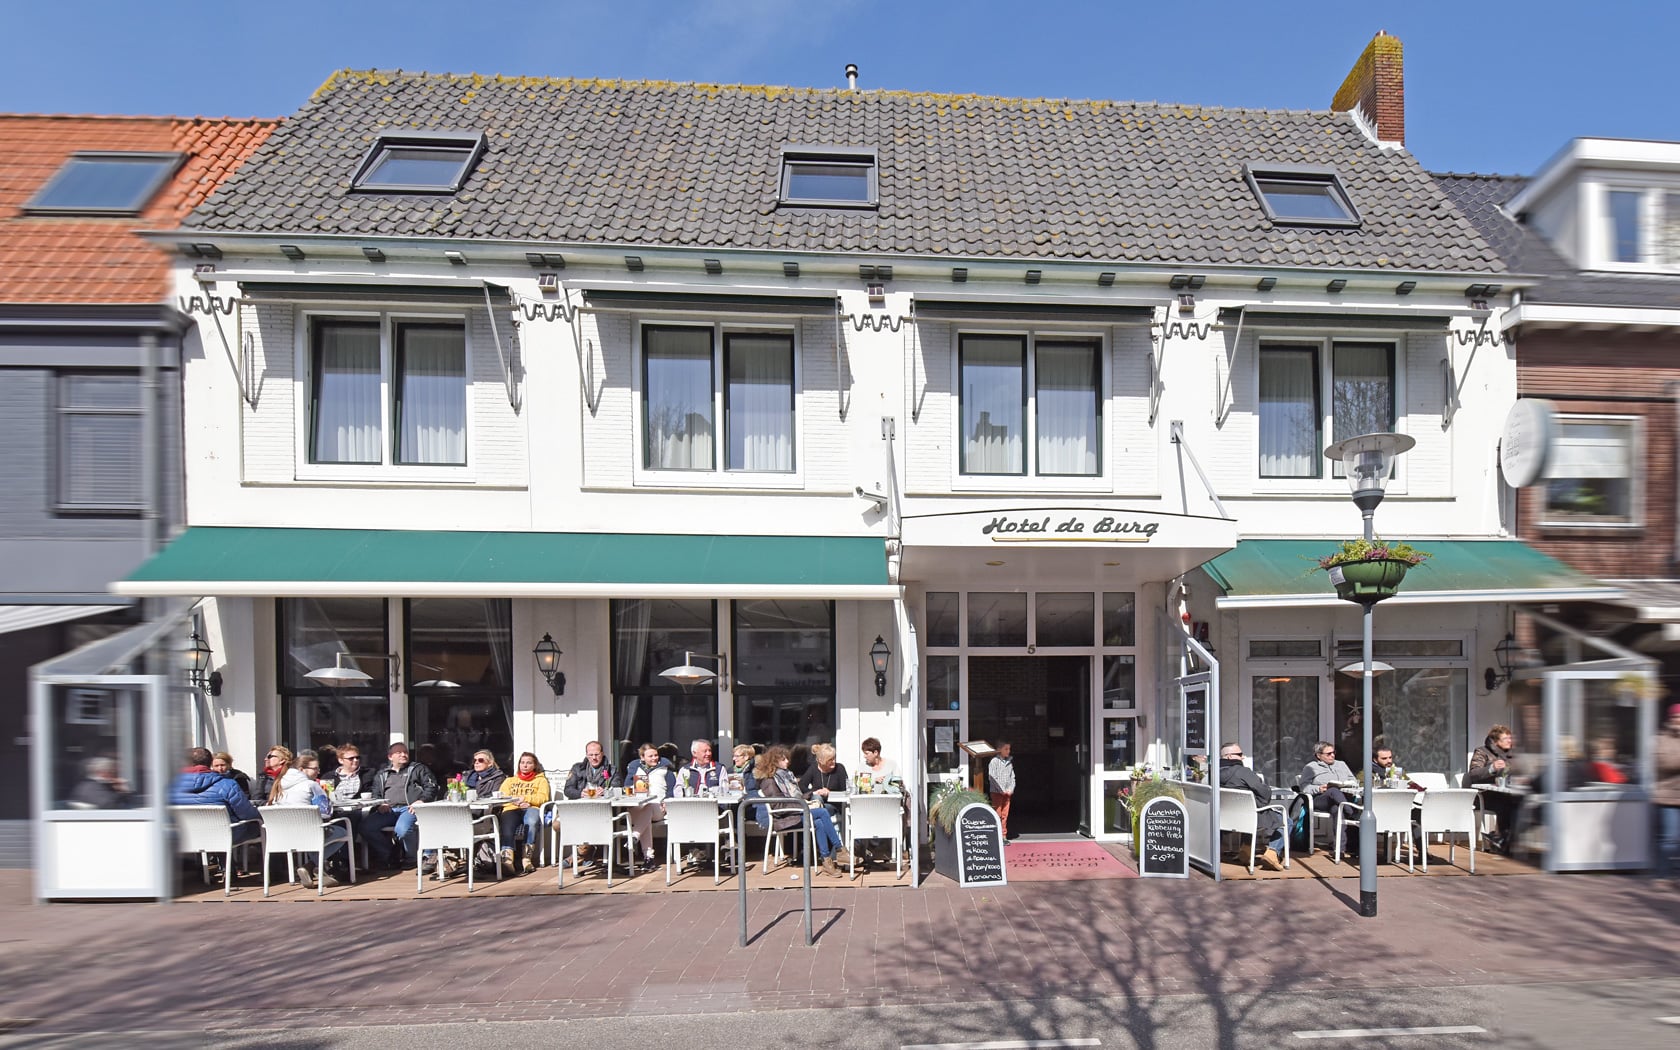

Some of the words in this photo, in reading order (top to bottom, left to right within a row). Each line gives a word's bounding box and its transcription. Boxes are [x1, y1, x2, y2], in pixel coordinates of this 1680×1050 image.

[982, 516, 1051, 535] Hotel
[1054, 516, 1085, 533] de
[1093, 516, 1160, 537] Burg
[1027, 643, 1036, 655] 5
